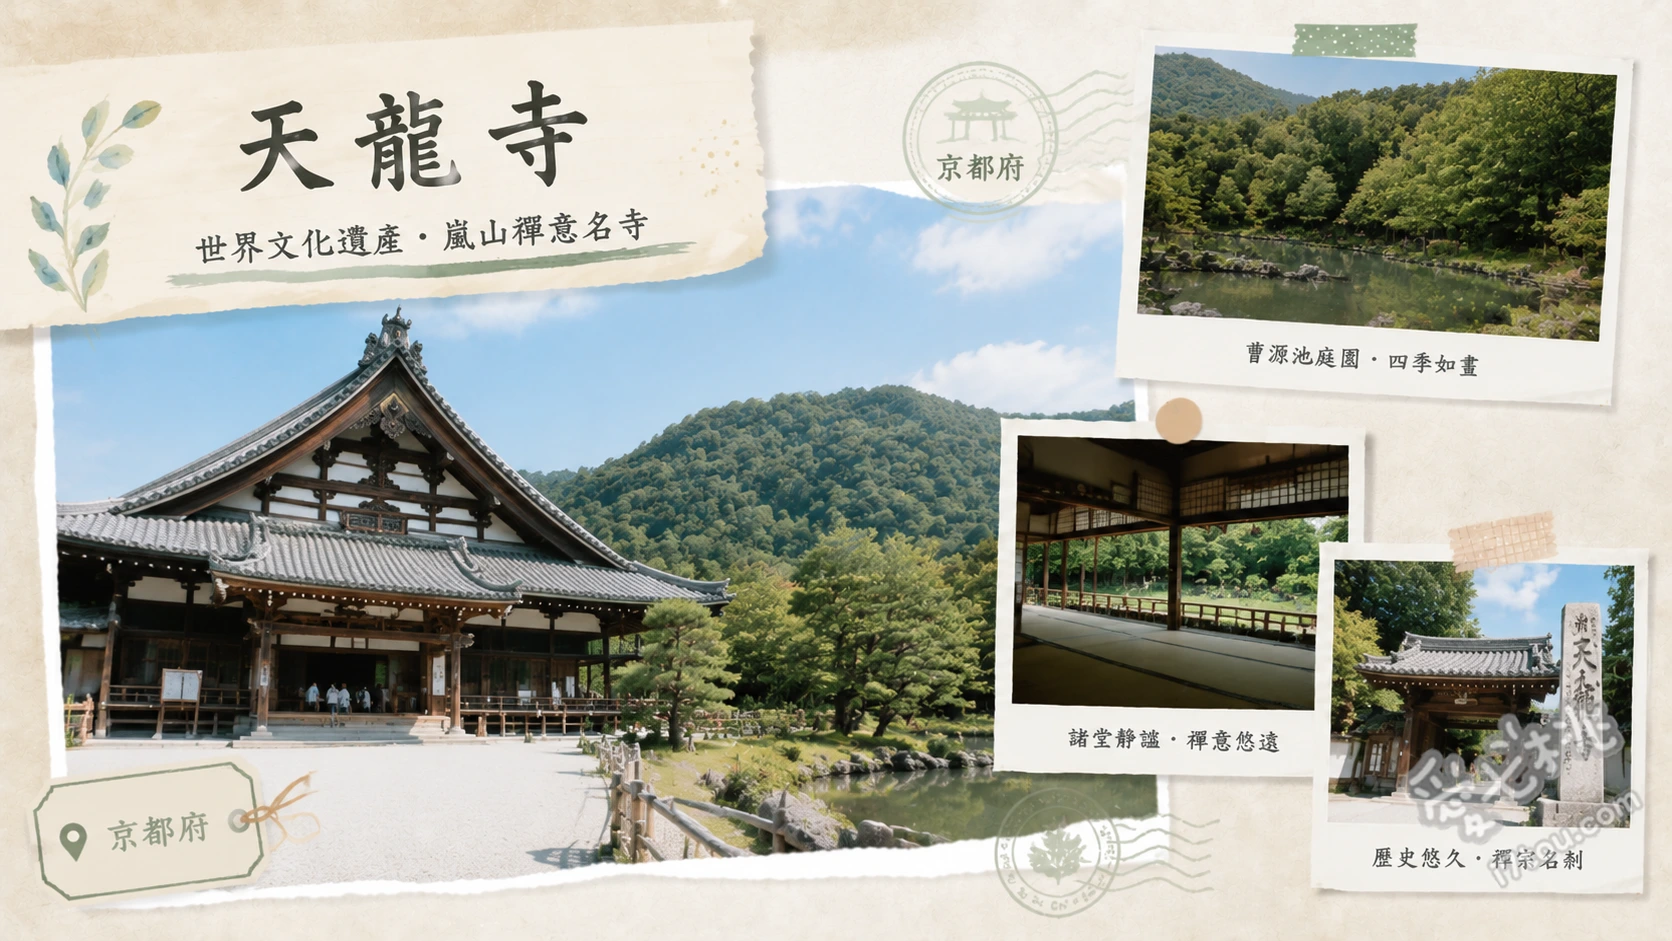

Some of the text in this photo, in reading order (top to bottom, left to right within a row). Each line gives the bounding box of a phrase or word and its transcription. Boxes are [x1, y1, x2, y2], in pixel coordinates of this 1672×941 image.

[239, 80, 588, 192] 天龍寺
[936, 152, 1025, 182] 京都府
[107, 811, 209, 852] 京都府
